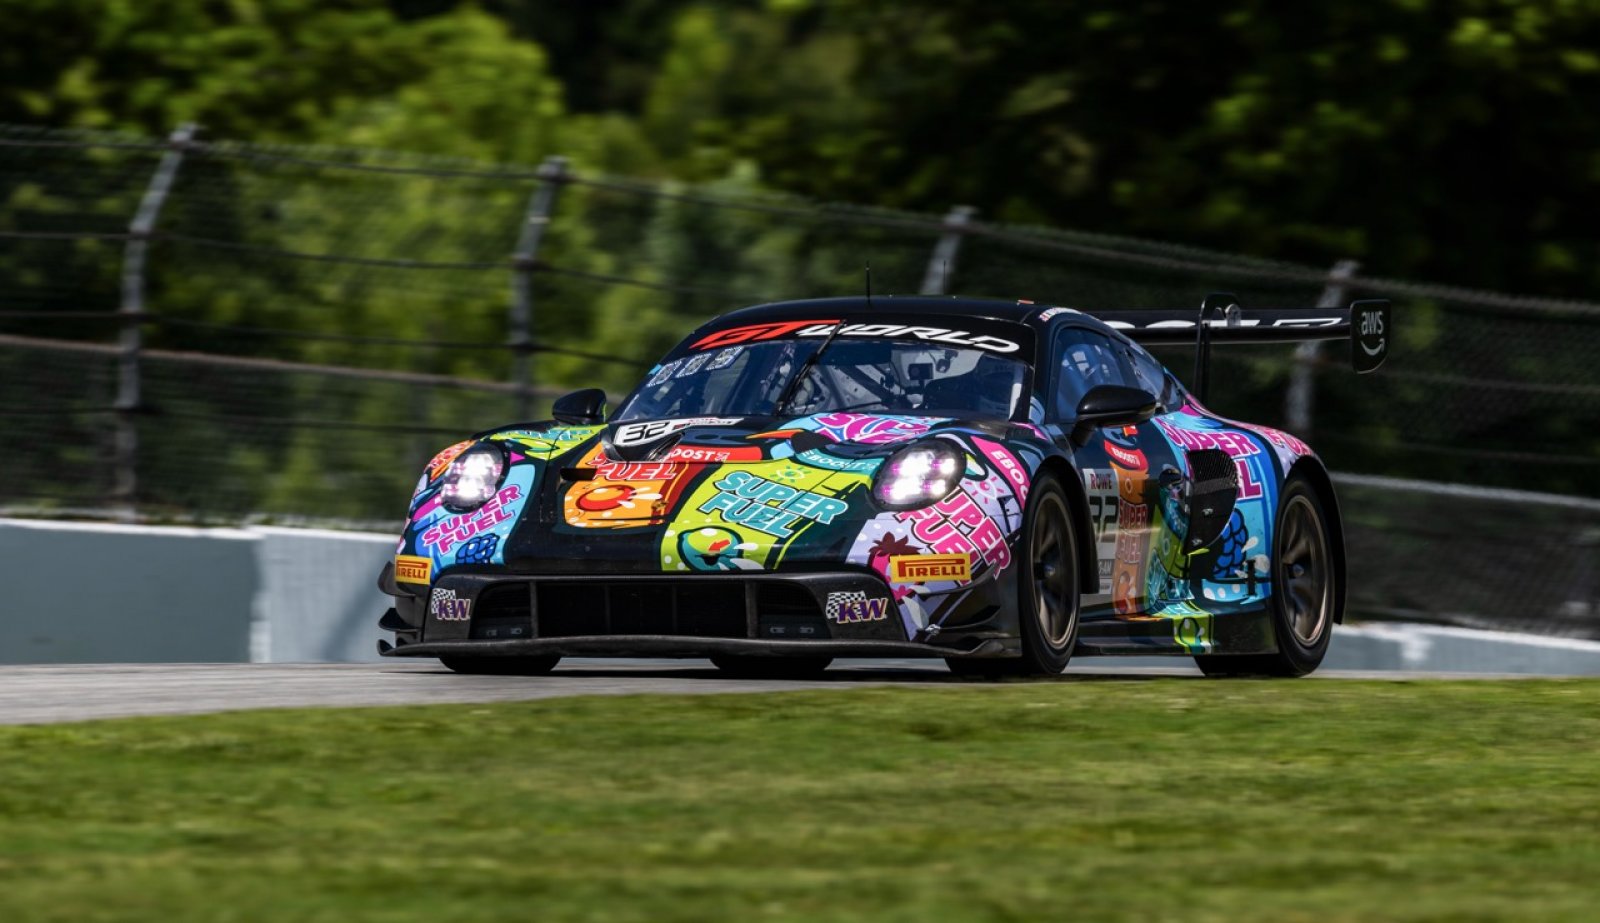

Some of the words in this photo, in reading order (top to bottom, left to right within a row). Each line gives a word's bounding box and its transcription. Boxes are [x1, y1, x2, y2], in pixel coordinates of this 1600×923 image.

[1361, 311, 1384, 335] aws
[623, 421, 671, 443] 32
[661, 448, 715, 461] OOST
[592, 461, 677, 481] FUEL
[715, 470, 848, 525] SUPER
[698, 492, 796, 539] FUEL
[436, 508, 514, 555] FUEL
[931, 487, 1008, 580] UPER
[897, 558, 965, 577] PIRELLI
[437, 598, 471, 620] KW
[836, 598, 888, 624] KW
